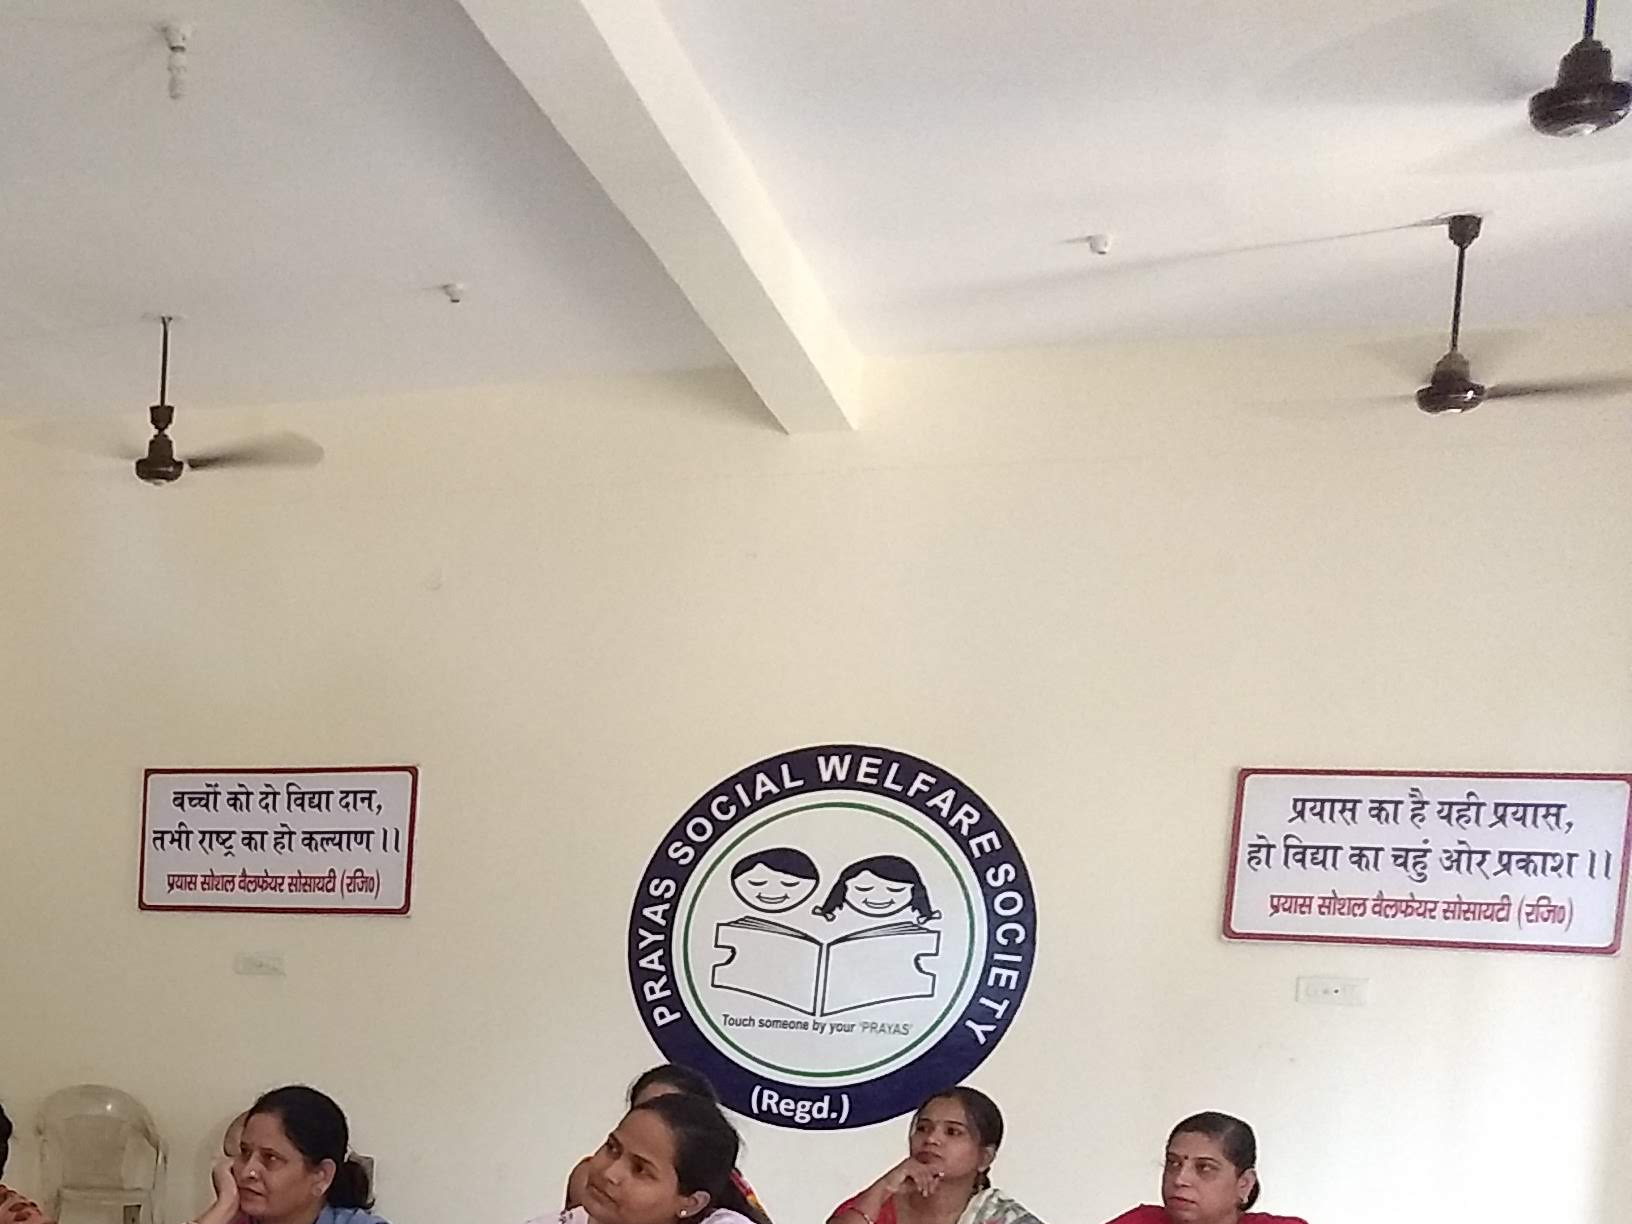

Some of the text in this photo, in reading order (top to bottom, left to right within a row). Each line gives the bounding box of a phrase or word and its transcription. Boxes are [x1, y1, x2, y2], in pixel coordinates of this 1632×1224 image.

[226, 783, 254, 813] को
[258, 783, 281, 813] दो
[286, 782, 335, 813] विद्या
[338, 790, 382, 816] दान,
[1288, 787, 1574, 834] प्रयास का है यही प्रयास,
[152, 821, 194, 851] तभी
[198, 830, 237, 857] राष्ट्र
[241, 830, 269, 852] का
[273, 822, 297, 855] हो
[301, 830, 375, 853] कल्याण
[1247, 833, 1276, 871] हो
[1283, 834, 1344, 871] विद्या
[1348, 846, 1385, 871] का
[1440, 839, 1491, 880] ओर
[1493, 849, 1579, 877] प्रकाश
[167, 873, 198, 894] प्रयास
[200, 868, 236, 892] सोशल
[288, 868, 337, 893] सोसायटी
[638, 754, 1027, 1046] PRAYAS SOCIAL WELFARE SOCIETY
[1269, 894, 1314, 917] प्रयास
[1317, 889, 1368, 917] सोशल
[1441, 894, 1512, 923] सोसायटी
[722, 1013, 755, 1028] Touch
[758, 1017, 809, 1031] someone
[812, 1019, 827, 1034] by
[829, 1024, 856, 1036] your
[750, 1085, 850, 1123] (Regd.)
